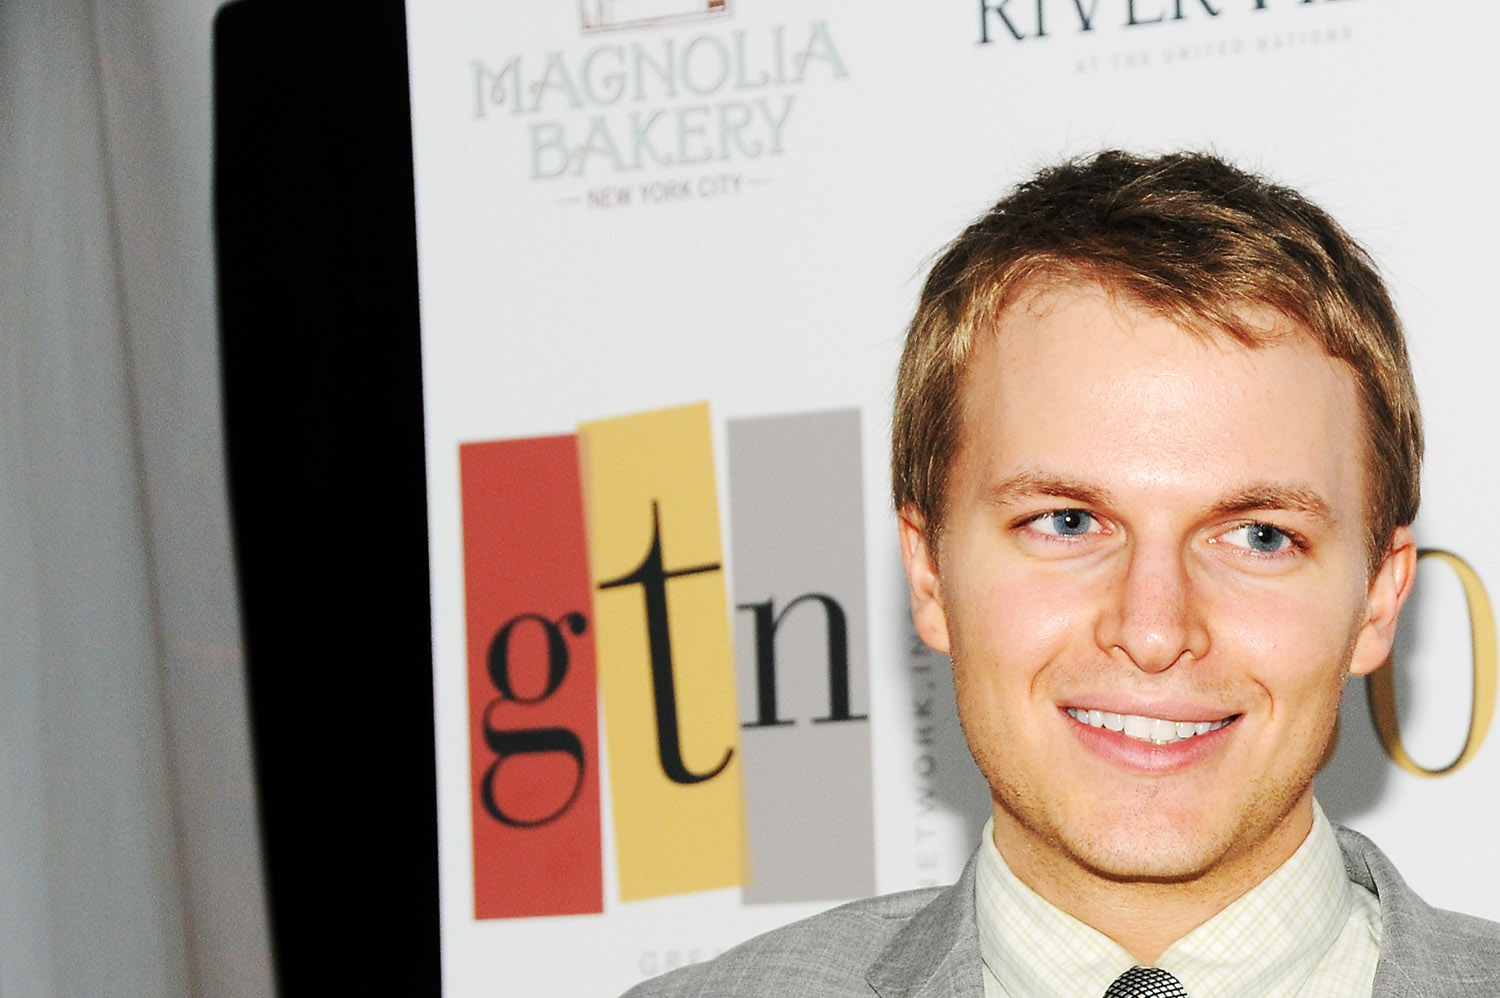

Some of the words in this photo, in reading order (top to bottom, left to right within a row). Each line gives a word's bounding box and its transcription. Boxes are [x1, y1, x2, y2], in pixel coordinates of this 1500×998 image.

[469, 20, 849, 118] MAGNOLIA
[1111, 48, 1152, 68] THE
[1163, 38, 1244, 64] UNITED
[1256, 25, 1353, 53] NATIONS
[529, 94, 795, 181] BAKERY
[586, 185, 632, 209] NEW
[639, 177, 693, 205] YORK
[697, 172, 744, 200] CITY
[480, 498, 869, 828] gtn
